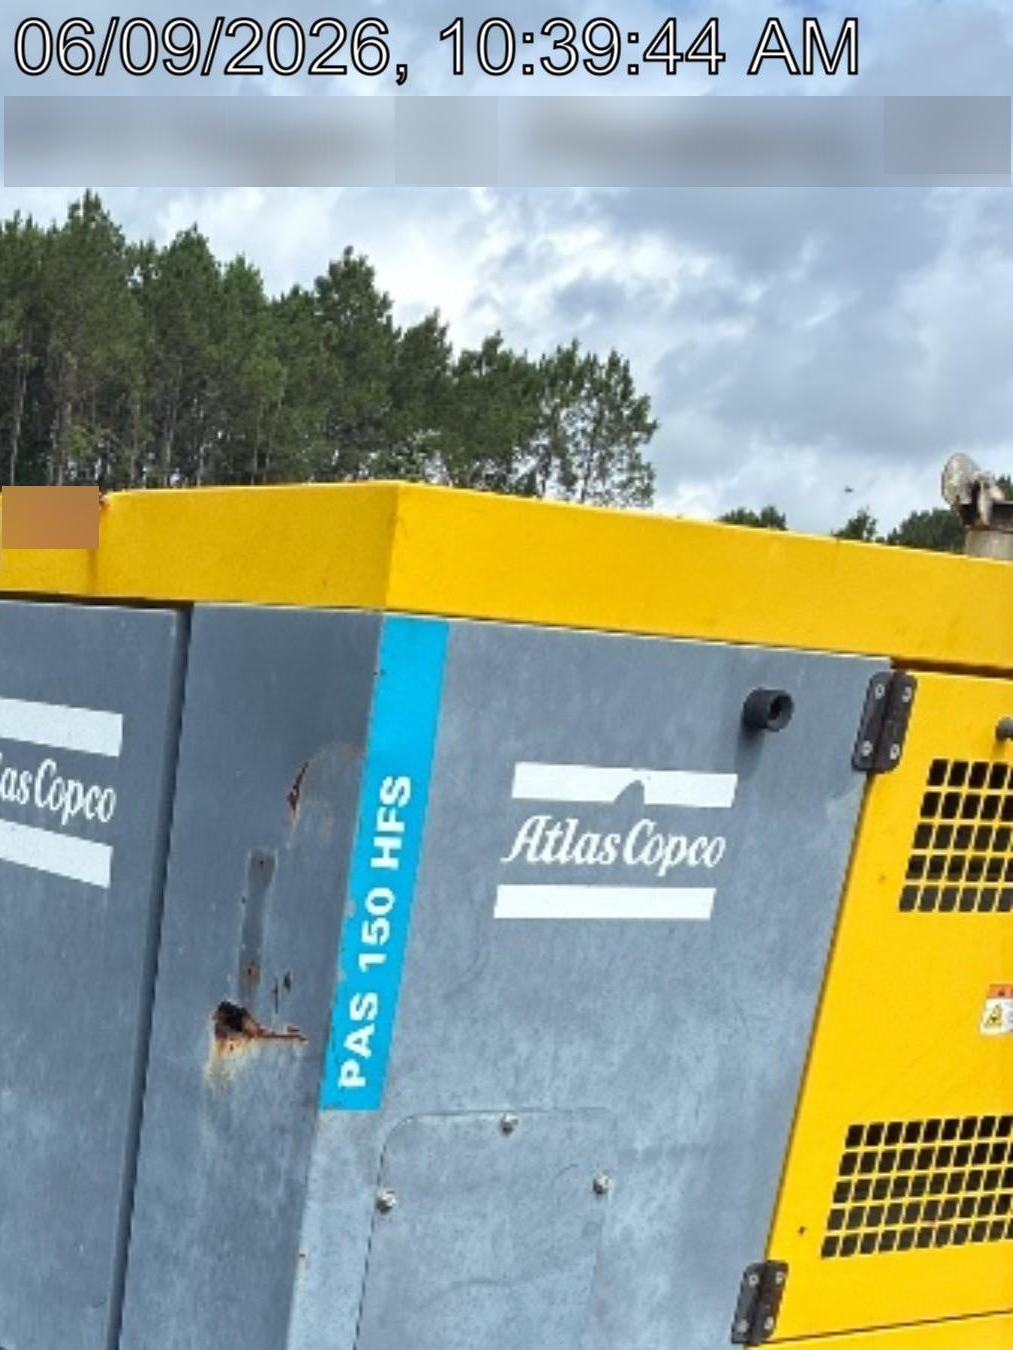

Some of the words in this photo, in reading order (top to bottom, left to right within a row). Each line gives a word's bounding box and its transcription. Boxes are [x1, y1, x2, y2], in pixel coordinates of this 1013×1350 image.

[34, 758, 117, 826] Copco
[370, 775, 412, 870] HFS
[500, 815, 620, 865] Atlas
[622, 818, 726, 877] Copco
[358, 887, 396, 973] 150
[338, 992, 379, 1089] PAS
